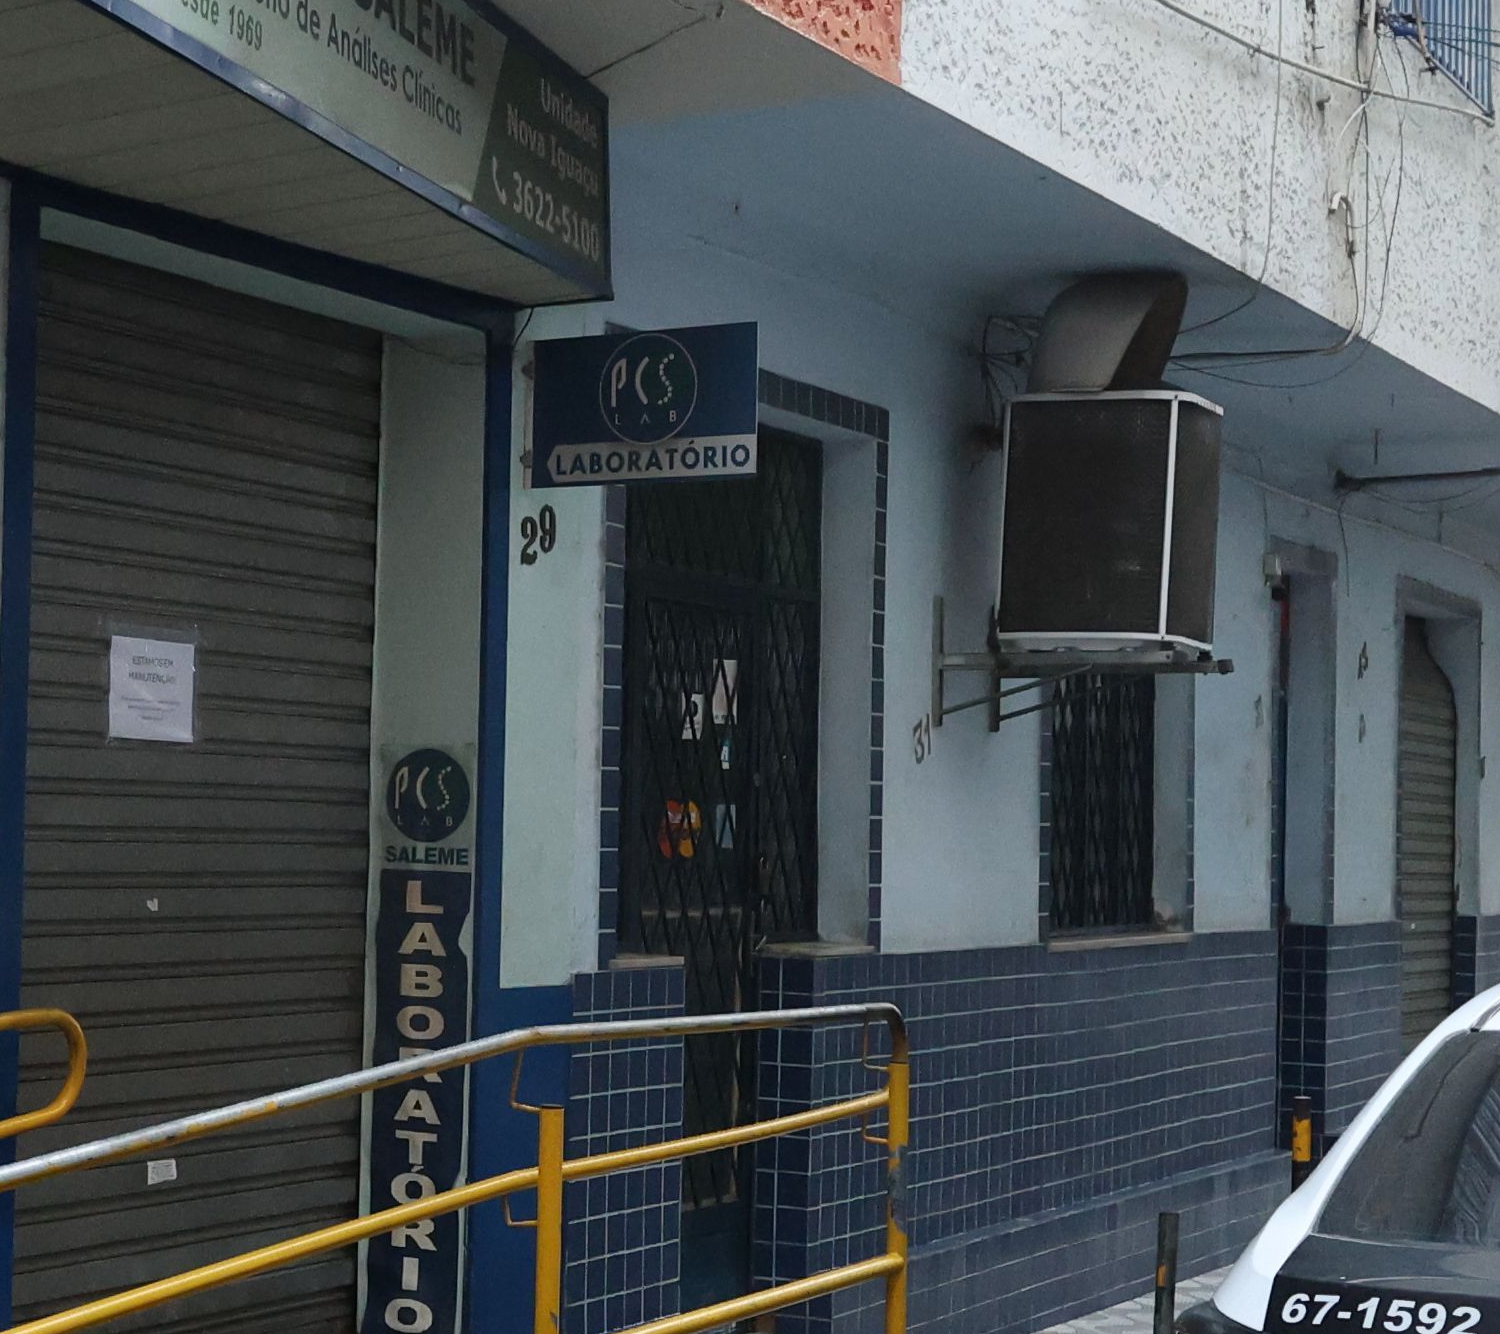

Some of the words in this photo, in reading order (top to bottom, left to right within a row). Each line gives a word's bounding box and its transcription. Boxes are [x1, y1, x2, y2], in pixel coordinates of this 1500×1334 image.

[227, 4, 263, 53] 1969
[326, 16, 398, 93] Análises
[401, 64, 463, 136] Clínicas
[506, 102, 546, 158] Nova
[540, 77, 598, 149] Unidade
[512, 171, 599, 262] 3622-5100
[610, 352, 675, 408] PCS
[614, 410, 677, 425] LAB
[555, 439, 751, 476] LABORATÓRIO
[520, 504, 557, 566] 29
[912, 713, 931, 764] 31
[394, 766, 452, 811] PCS
[396, 815, 454, 828] LAB
[385, 845, 469, 867] SALEME
